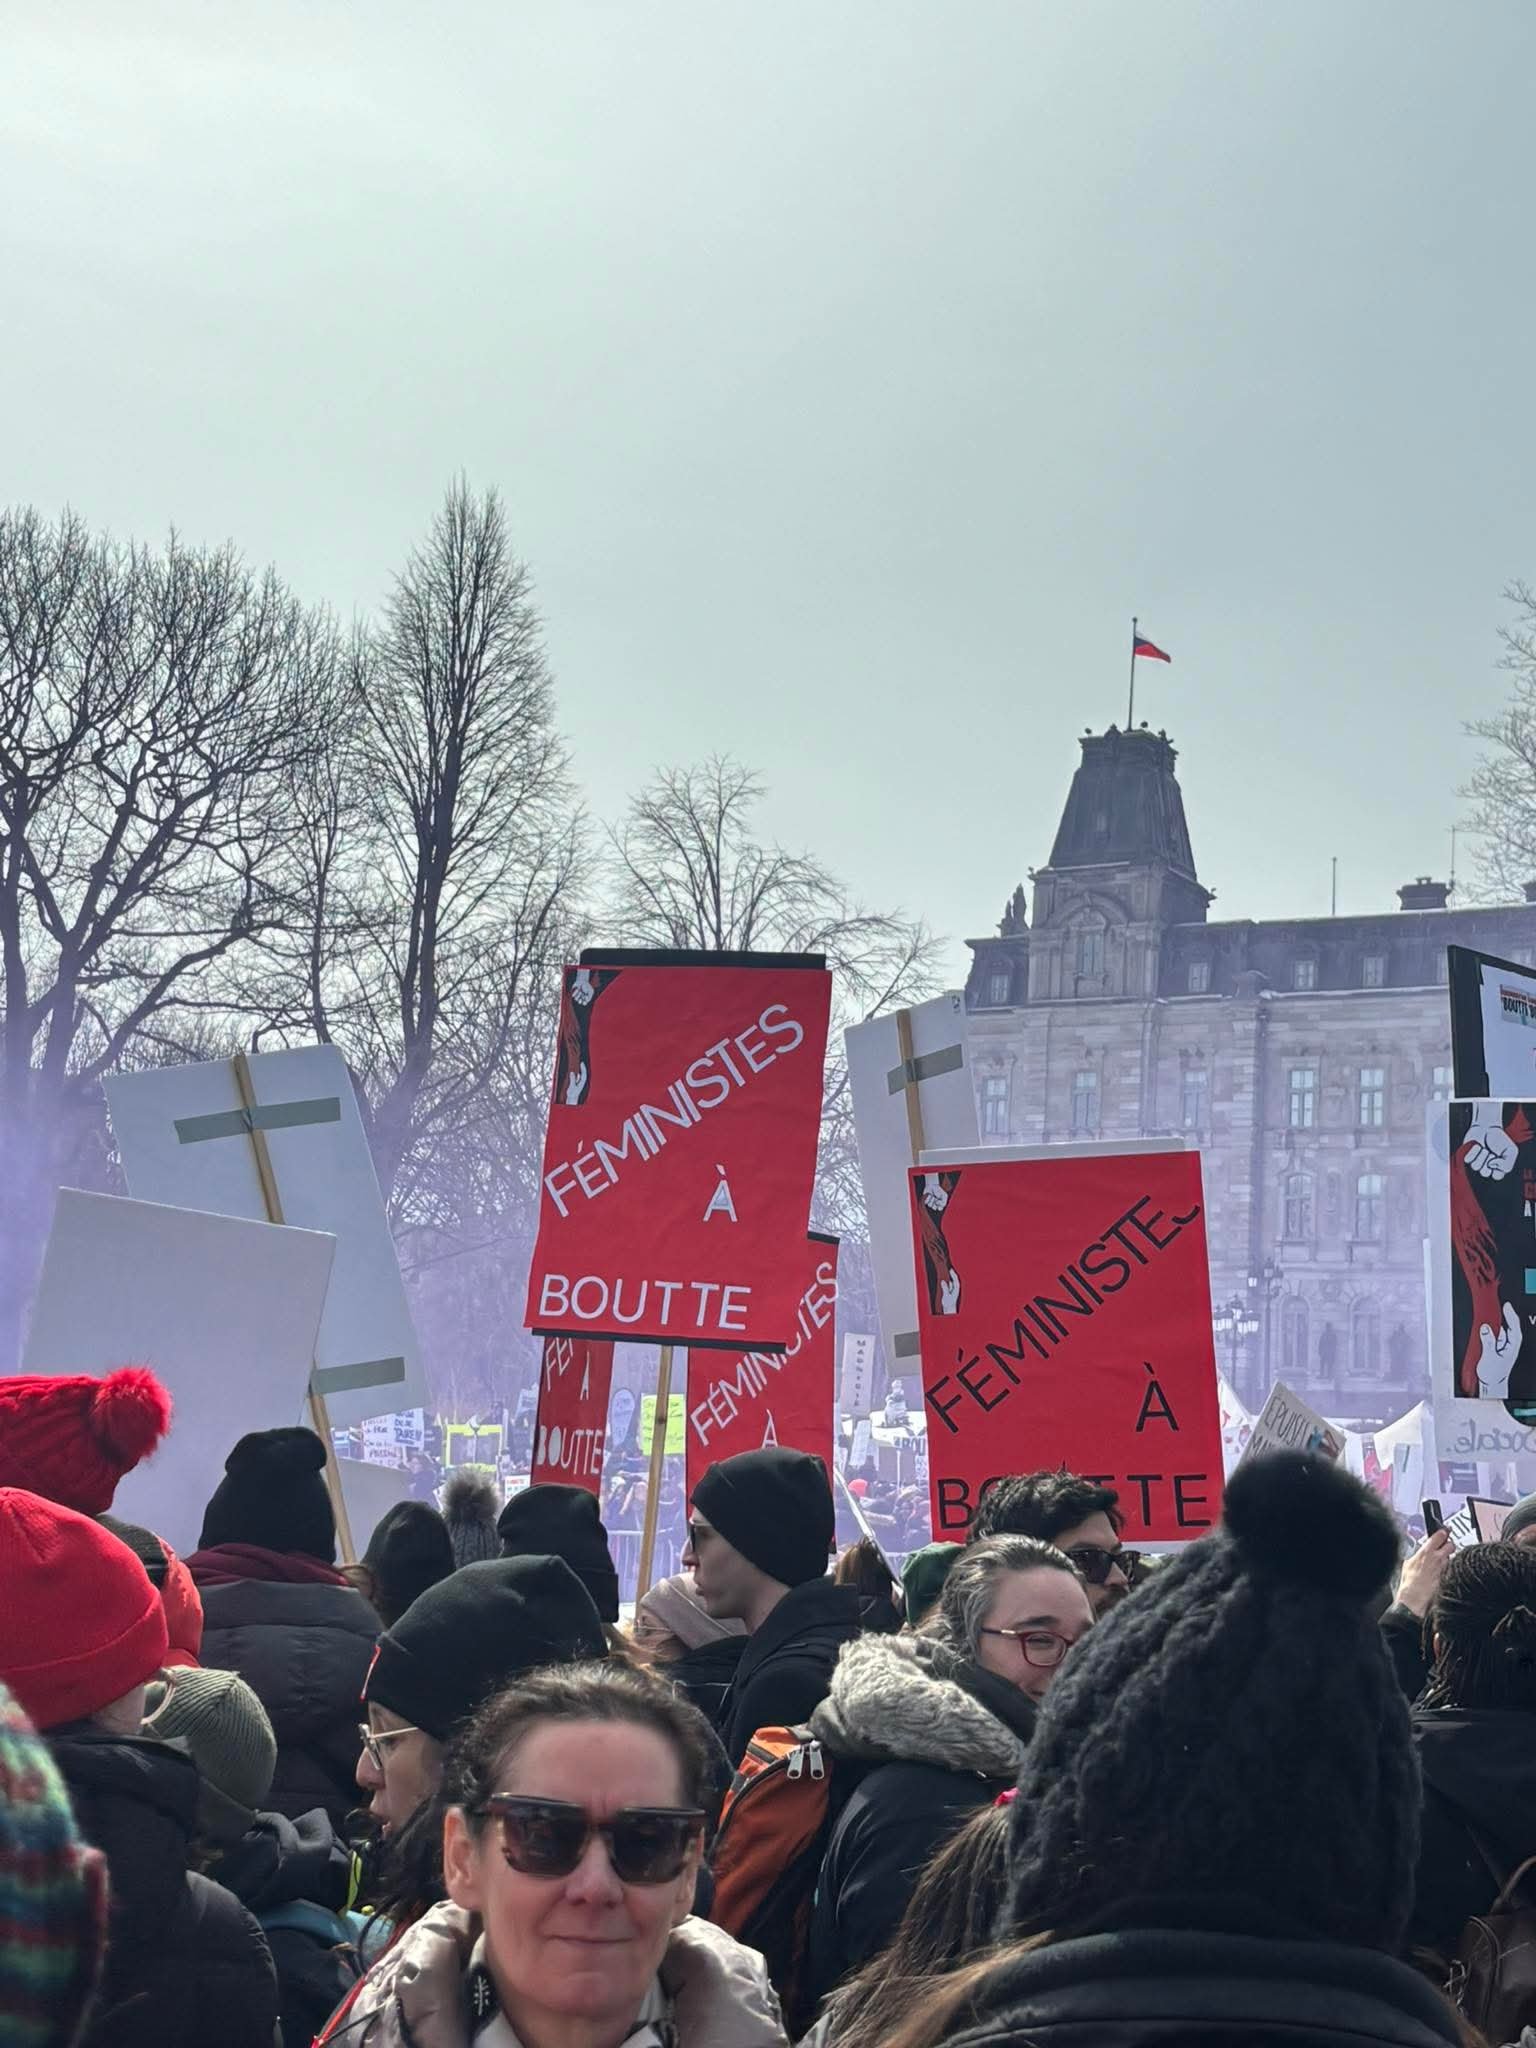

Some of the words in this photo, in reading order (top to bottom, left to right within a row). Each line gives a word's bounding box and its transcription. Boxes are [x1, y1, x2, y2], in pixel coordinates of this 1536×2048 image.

[544, 1004, 804, 1217] FÉMINISTES
[703, 1164, 738, 1223] À
[538, 1273, 752, 1331] BOUTTE
[1136, 1361, 1180, 1432] À
[536, 1424, 604, 1475] BOUTTE
[937, 1474, 1211, 1530] BTE
